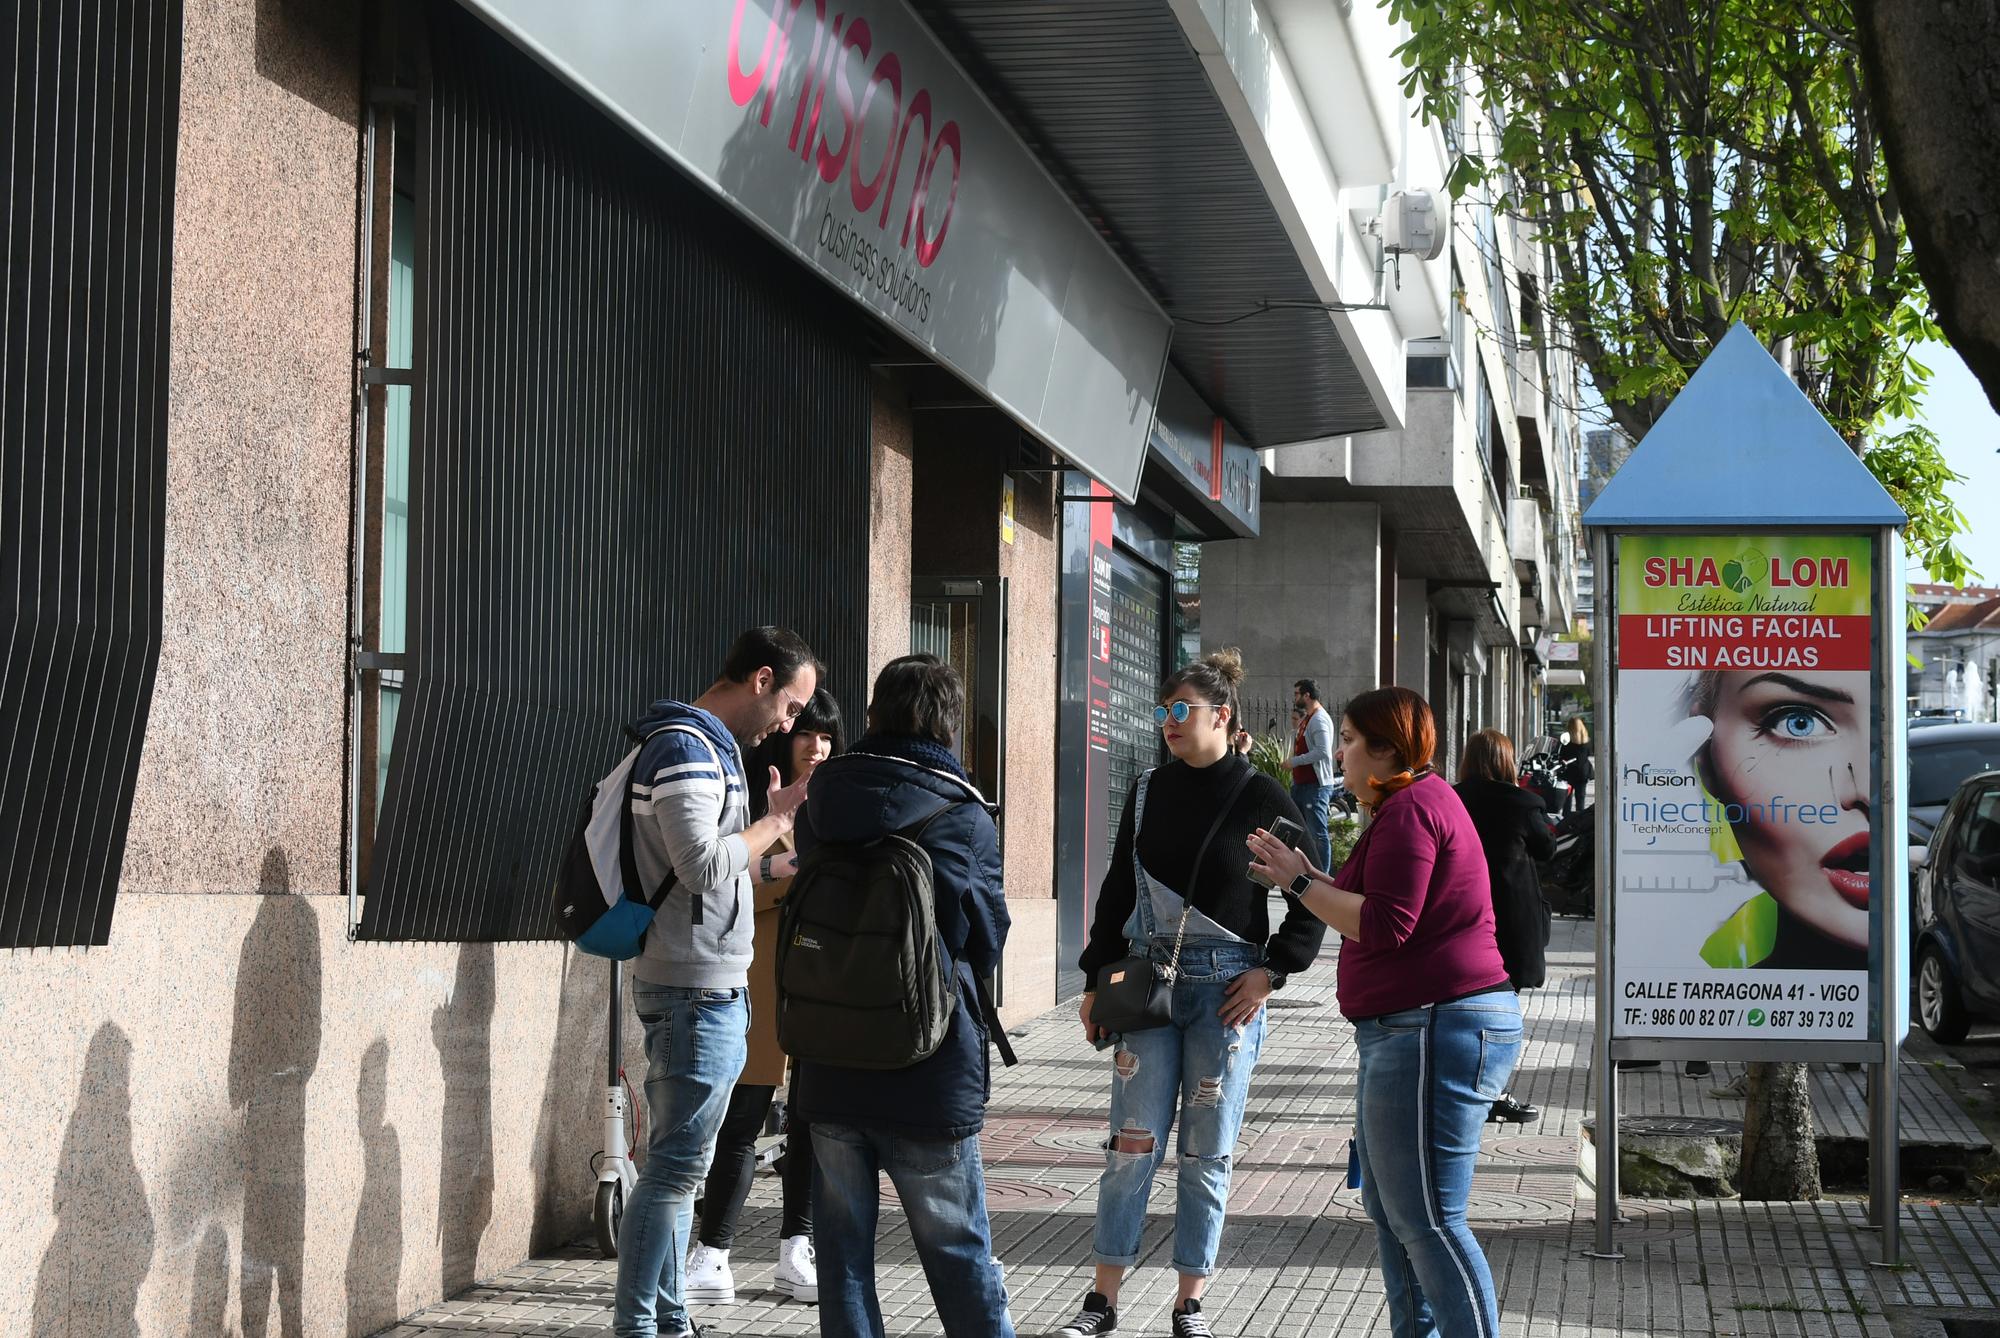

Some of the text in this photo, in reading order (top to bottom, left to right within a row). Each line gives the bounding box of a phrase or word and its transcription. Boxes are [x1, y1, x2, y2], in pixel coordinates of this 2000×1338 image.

[728, 0, 961, 268] unisono
[818, 197, 931, 323] business solutions
[1677, 593, 1817, 612] Estética Natural
[1646, 617, 1841, 638] LIFTING FACIAL
[1666, 646, 1819, 667] SIN AGUJAS
[1632, 824, 1722, 835] TechMixConcept
[1624, 982, 1677, 999] CALLE
[1682, 983, 1783, 1001] TARRAGONA
[1787, 984, 1804, 1001] 41
[1819, 985, 1859, 1001] VIGO
[1651, 1009, 1675, 1026] 986
[1679, 1009, 1695, 1026] 00
[1699, 1010, 1715, 1026] 82
[1718, 1010, 1735, 1026] 07
[1770, 1010, 1794, 1027] 687
[1798, 1011, 1814, 1027] 39
[1818, 1011, 1834, 1027] 73
[1837, 1011, 1854, 1028] 02
